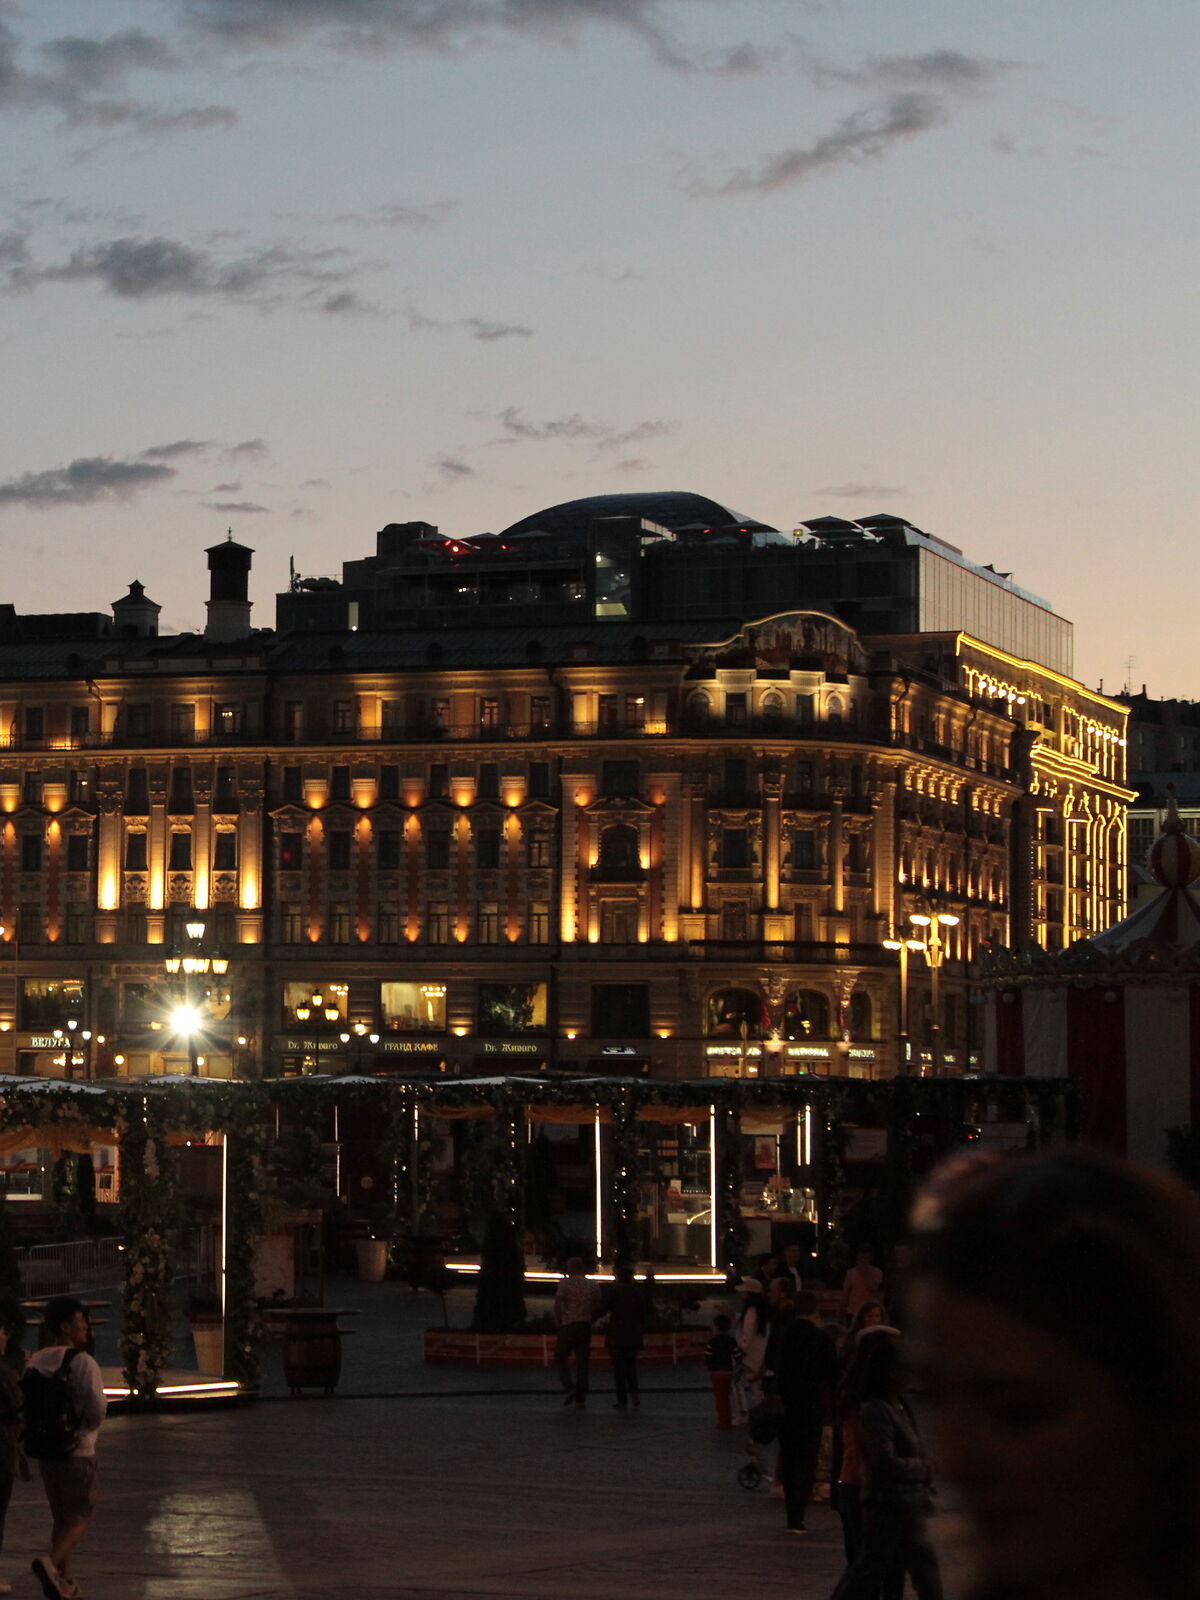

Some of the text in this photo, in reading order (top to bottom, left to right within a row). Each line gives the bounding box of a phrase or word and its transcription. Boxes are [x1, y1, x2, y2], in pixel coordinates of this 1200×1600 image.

[288, 1040, 300, 1049] Dr.
[384, 1042, 439, 1052] ГРАНД КАФЕ
[485, 1043, 537, 1052] Dr. Живаго
[788, 1047, 829, 1057] NATIONAL
